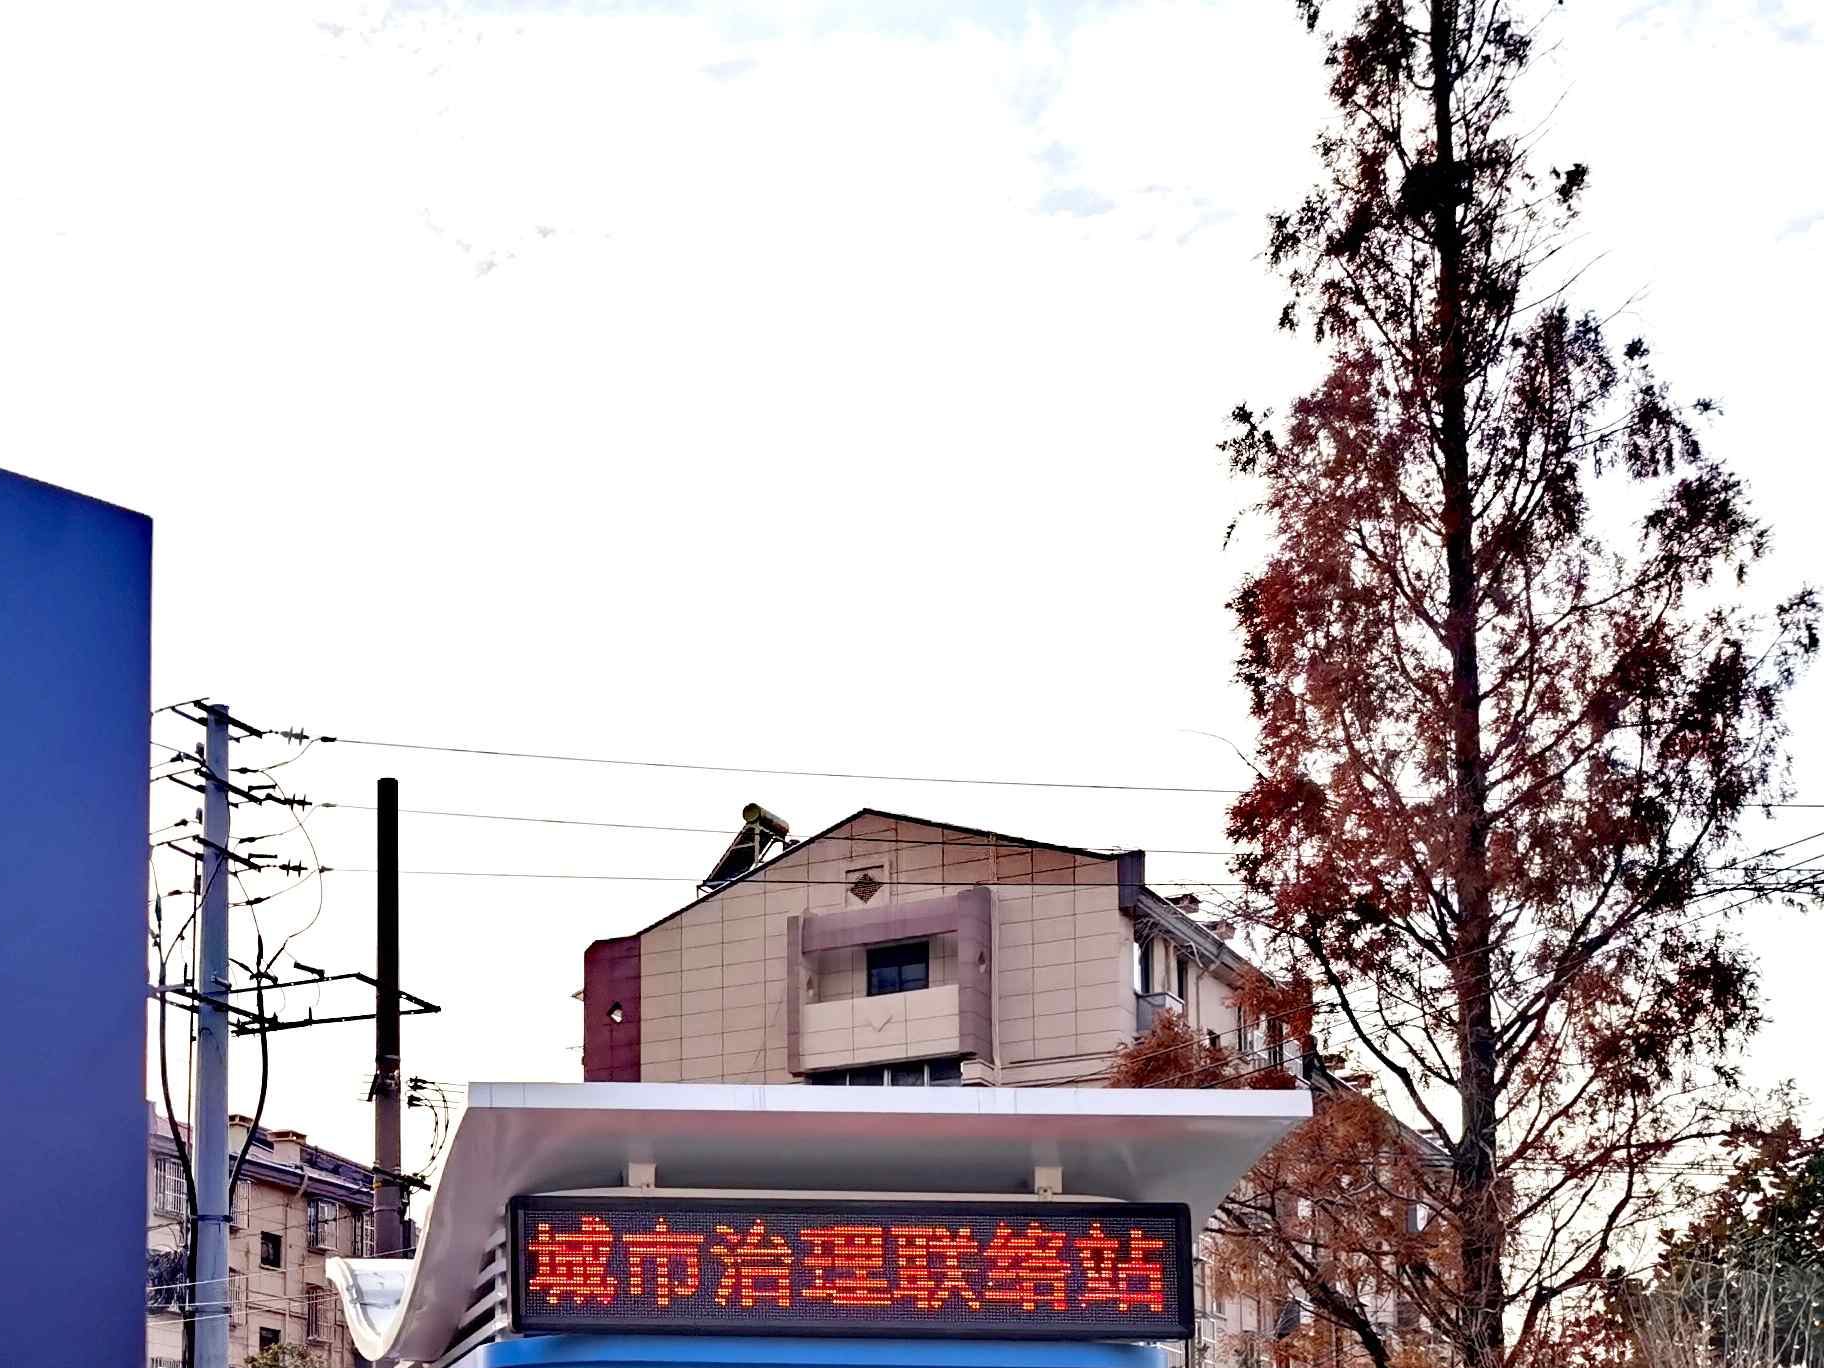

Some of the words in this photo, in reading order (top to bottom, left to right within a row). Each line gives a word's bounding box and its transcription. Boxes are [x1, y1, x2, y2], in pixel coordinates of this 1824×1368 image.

[528, 1215, 1166, 1312] 城市治理联络站
